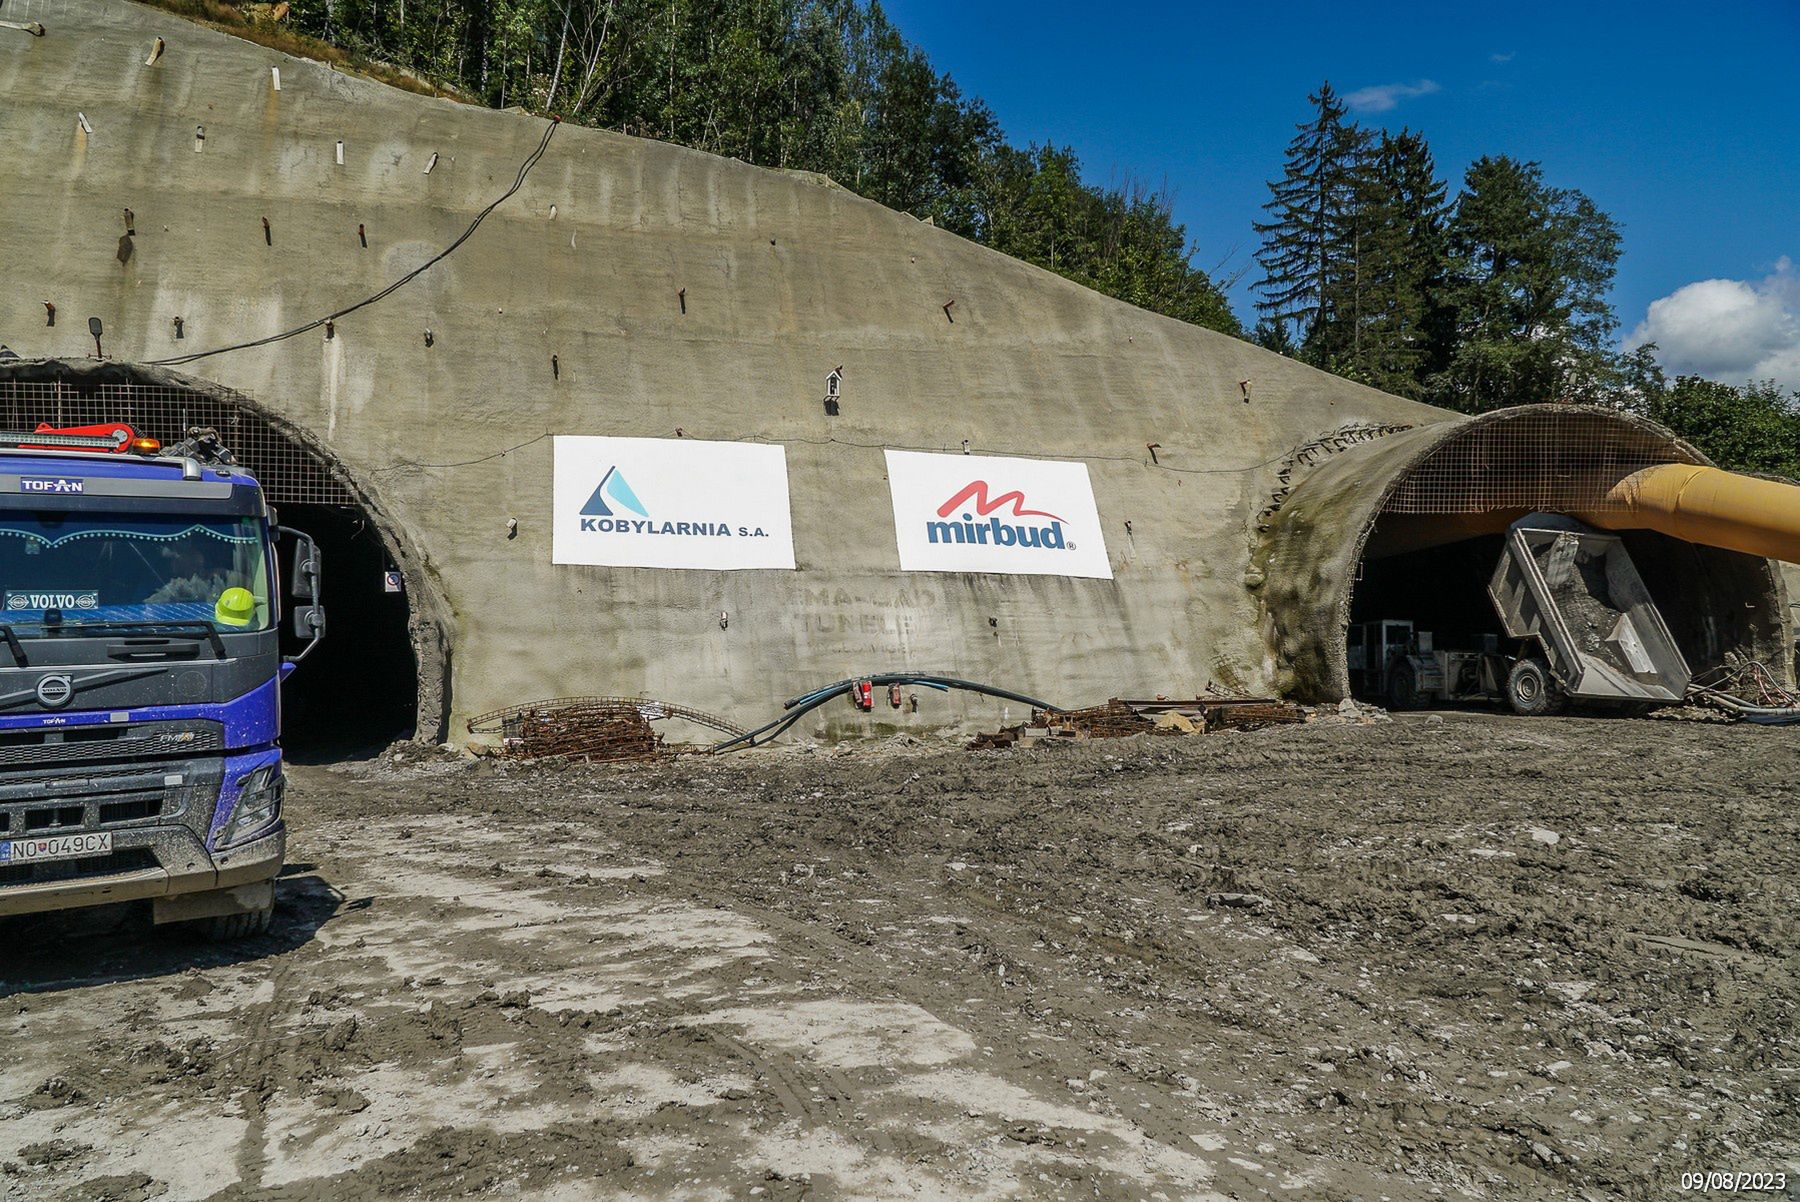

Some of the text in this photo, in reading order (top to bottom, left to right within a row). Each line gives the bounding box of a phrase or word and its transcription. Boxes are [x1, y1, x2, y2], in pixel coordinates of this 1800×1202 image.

[22, 479, 83, 492] TOFAN
[580, 518, 769, 537] KOBYLARNIA S.A.
[30, 594, 75, 609] VOLVO
[48, 834, 108, 854] 049CX
